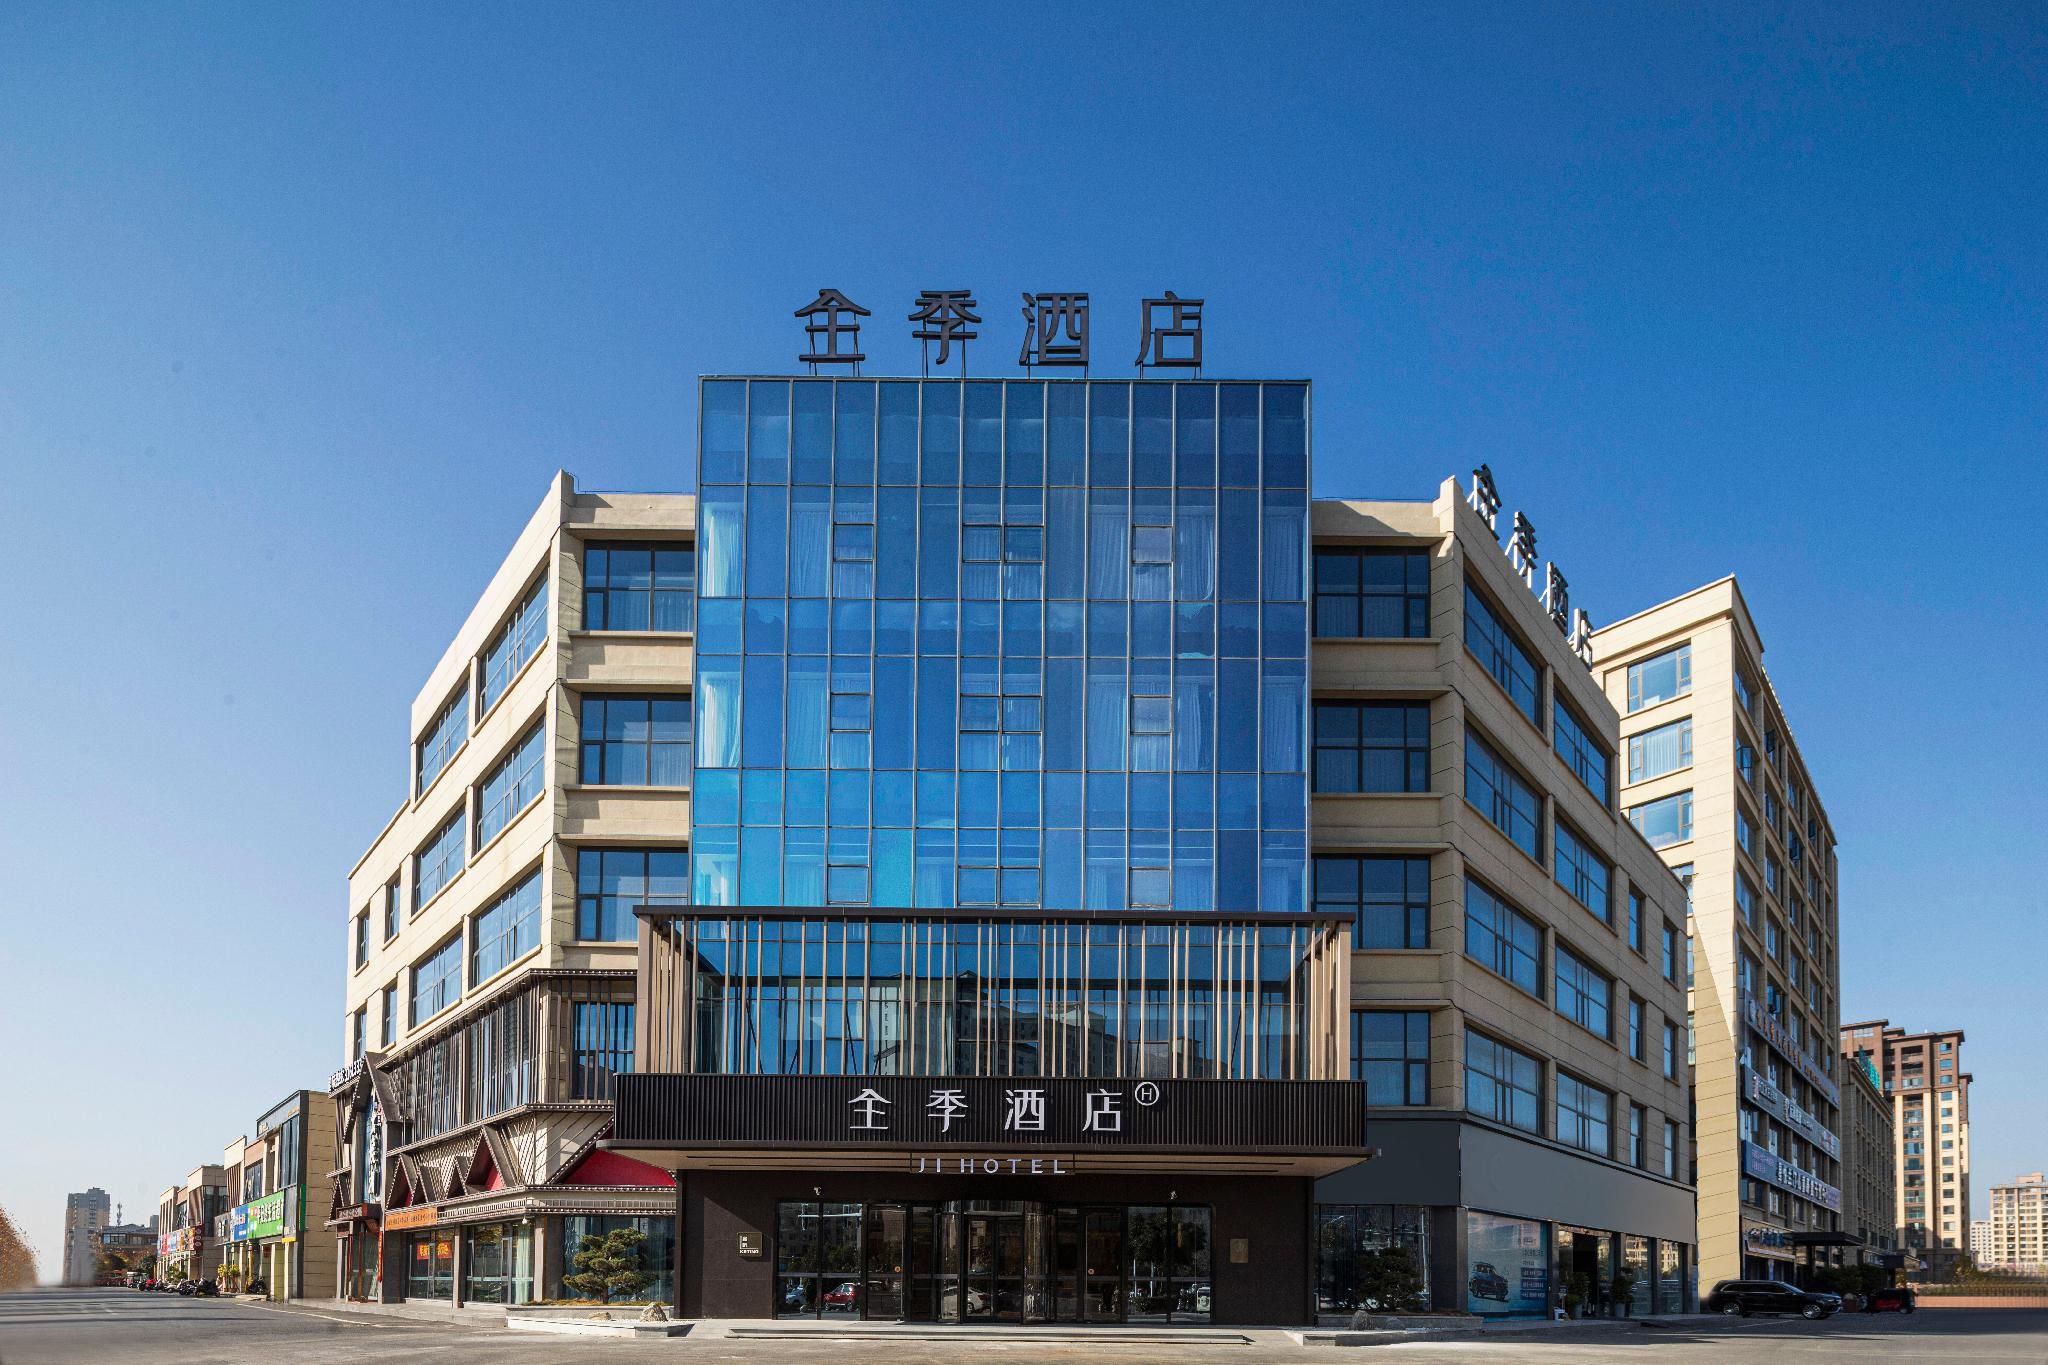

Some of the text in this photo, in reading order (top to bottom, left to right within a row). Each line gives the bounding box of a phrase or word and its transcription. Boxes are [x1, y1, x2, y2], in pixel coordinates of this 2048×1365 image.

[794, 289, 1204, 367] 全季酒店
[848, 1088, 1122, 1132] 全季酒店
[918, 1157, 1066, 1174] JI HOTEL
